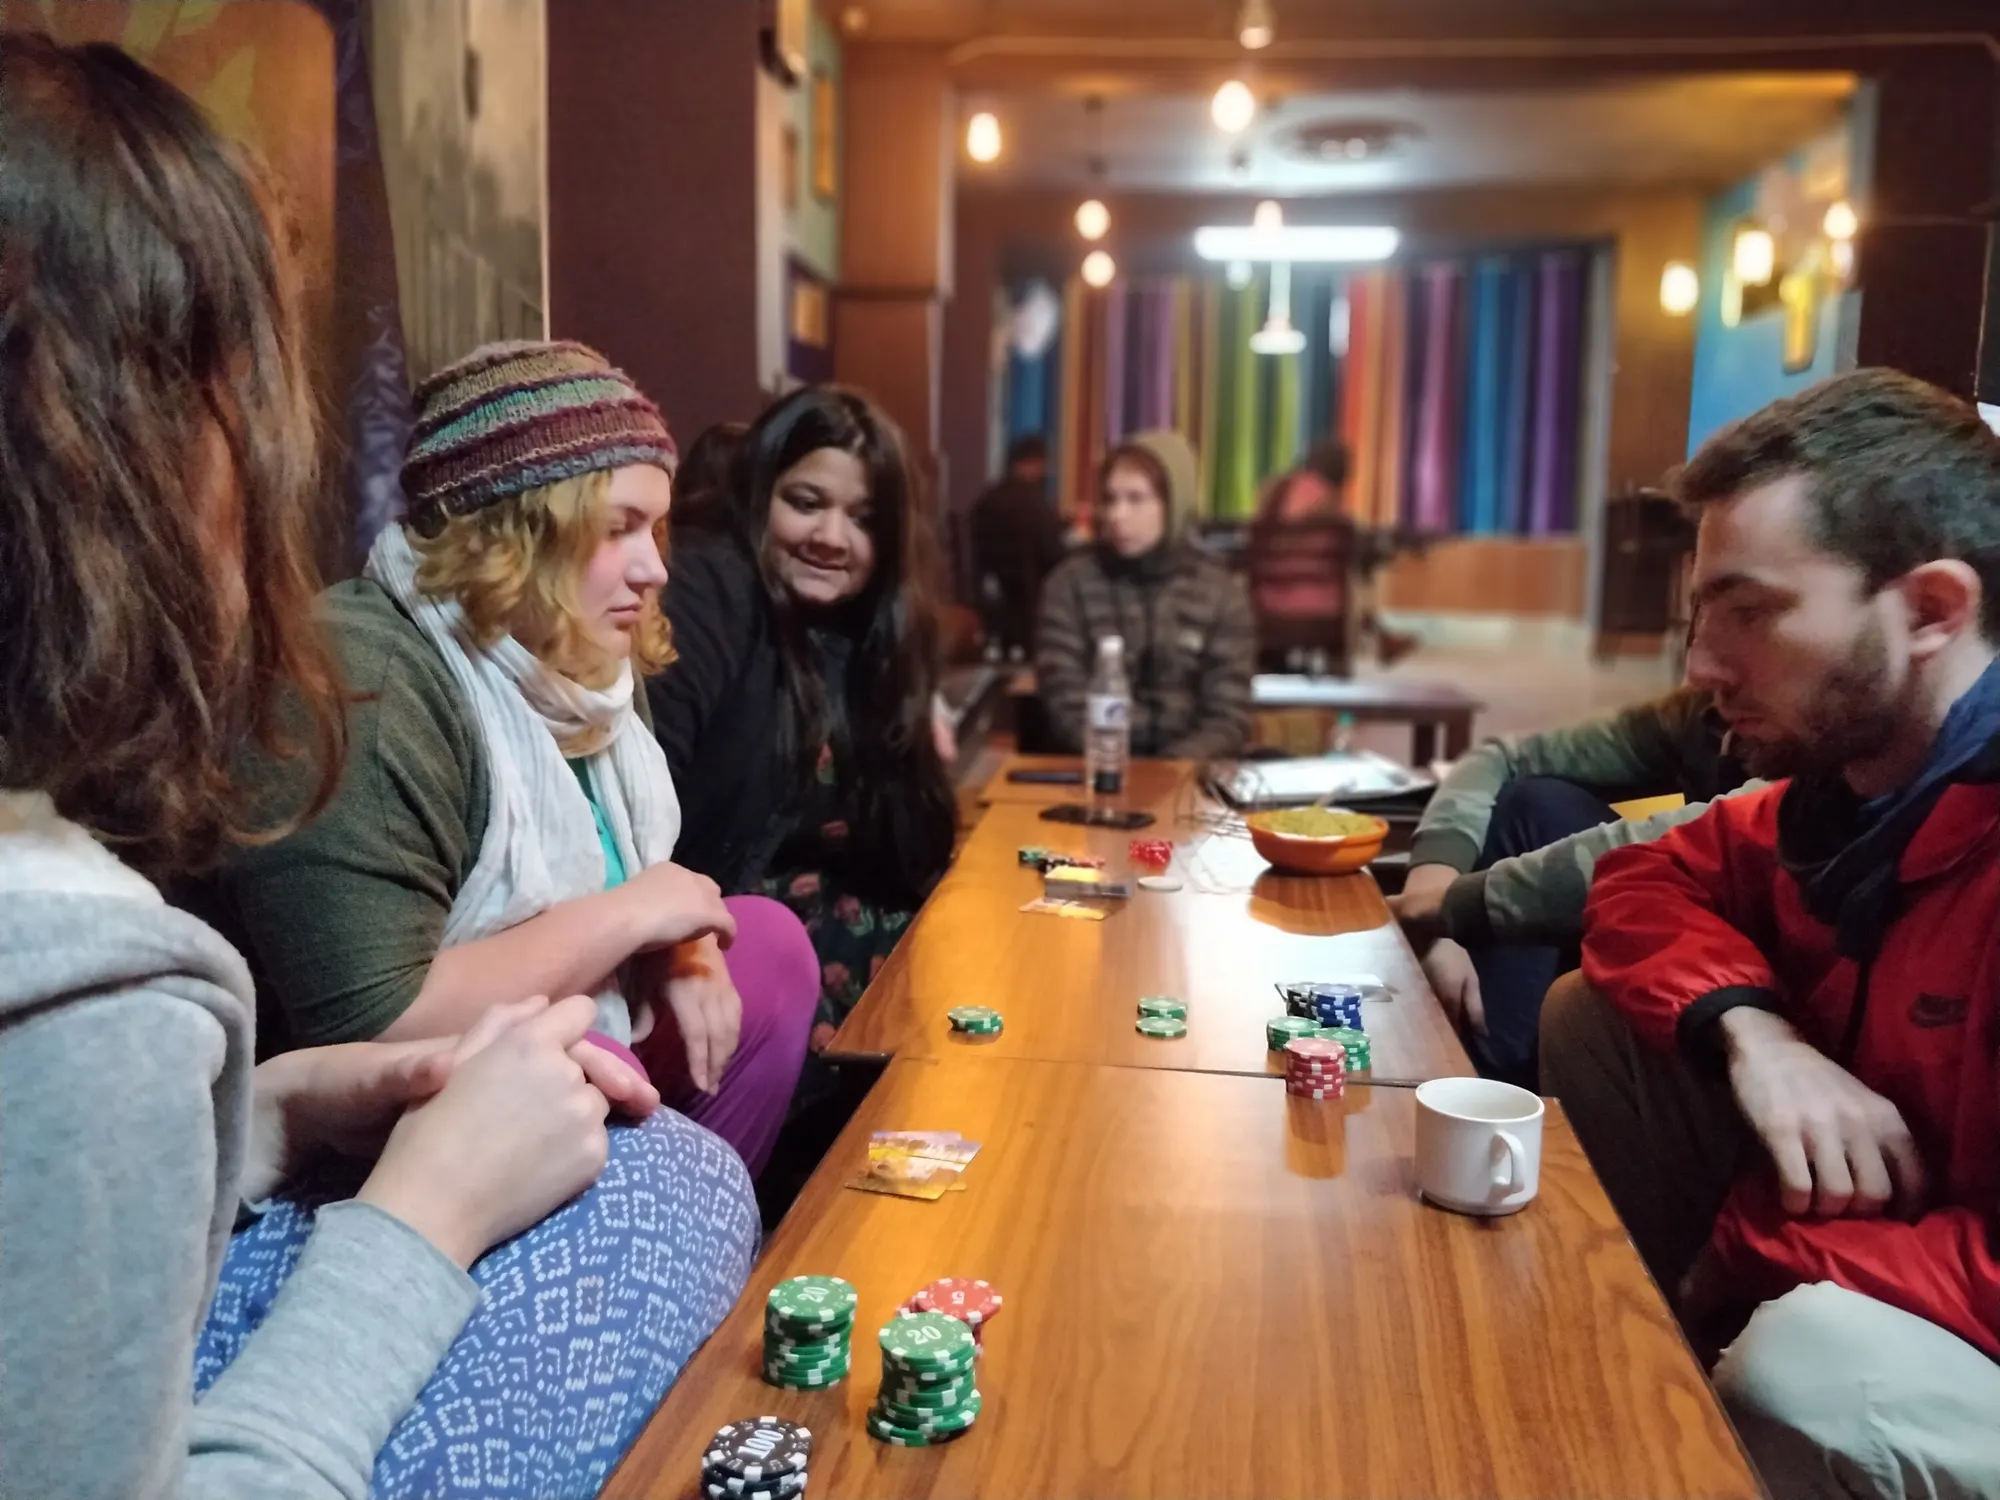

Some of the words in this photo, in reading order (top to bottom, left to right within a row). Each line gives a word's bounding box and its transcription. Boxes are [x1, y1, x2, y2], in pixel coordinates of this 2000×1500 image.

[797, 1286, 830, 1303] 20
[951, 1290, 965, 1305] 5
[906, 1325, 942, 1345] 20
[737, 1429, 784, 1459] 100
